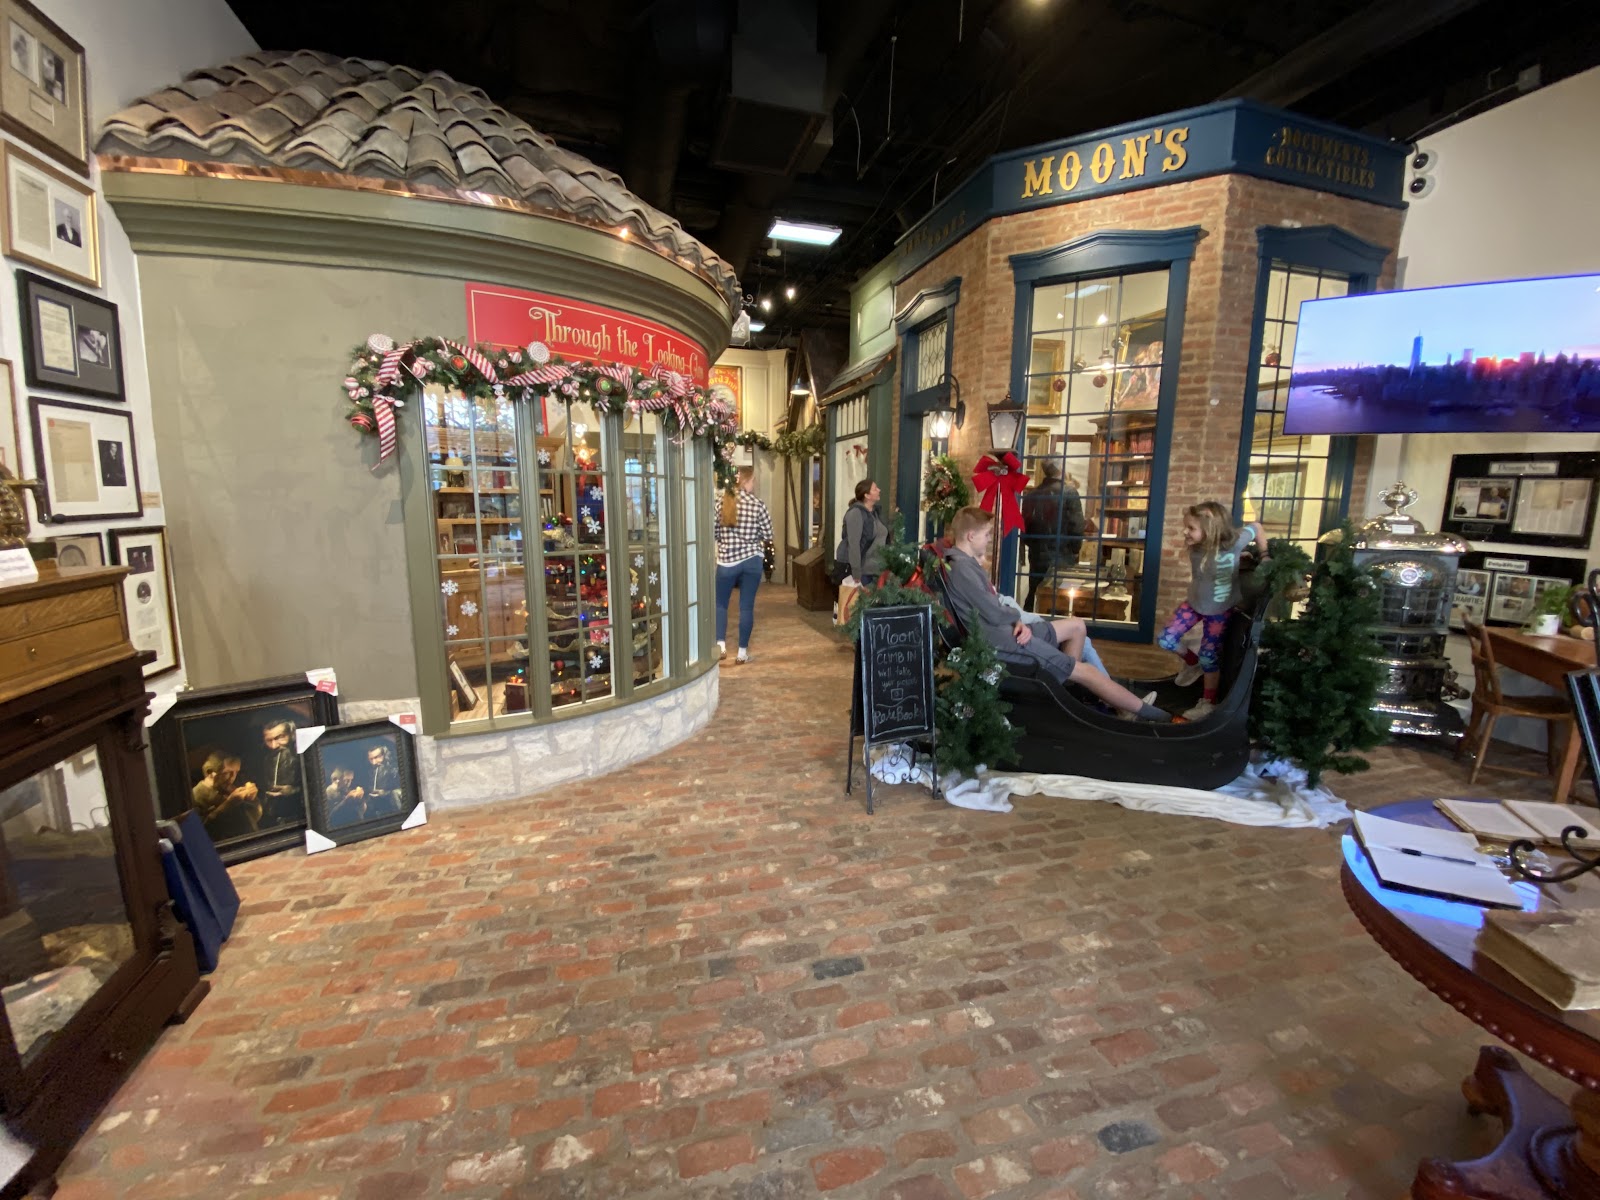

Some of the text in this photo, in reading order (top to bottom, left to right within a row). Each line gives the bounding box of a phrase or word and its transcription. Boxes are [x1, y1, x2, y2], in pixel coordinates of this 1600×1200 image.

[1021, 127, 1189, 198] MOON'S
[1264, 146, 1377, 189] COLLECTIBLES
[528, 306, 612, 356] Through
[616, 325, 639, 358] the
[877, 650, 917, 664] CLIMB IN
